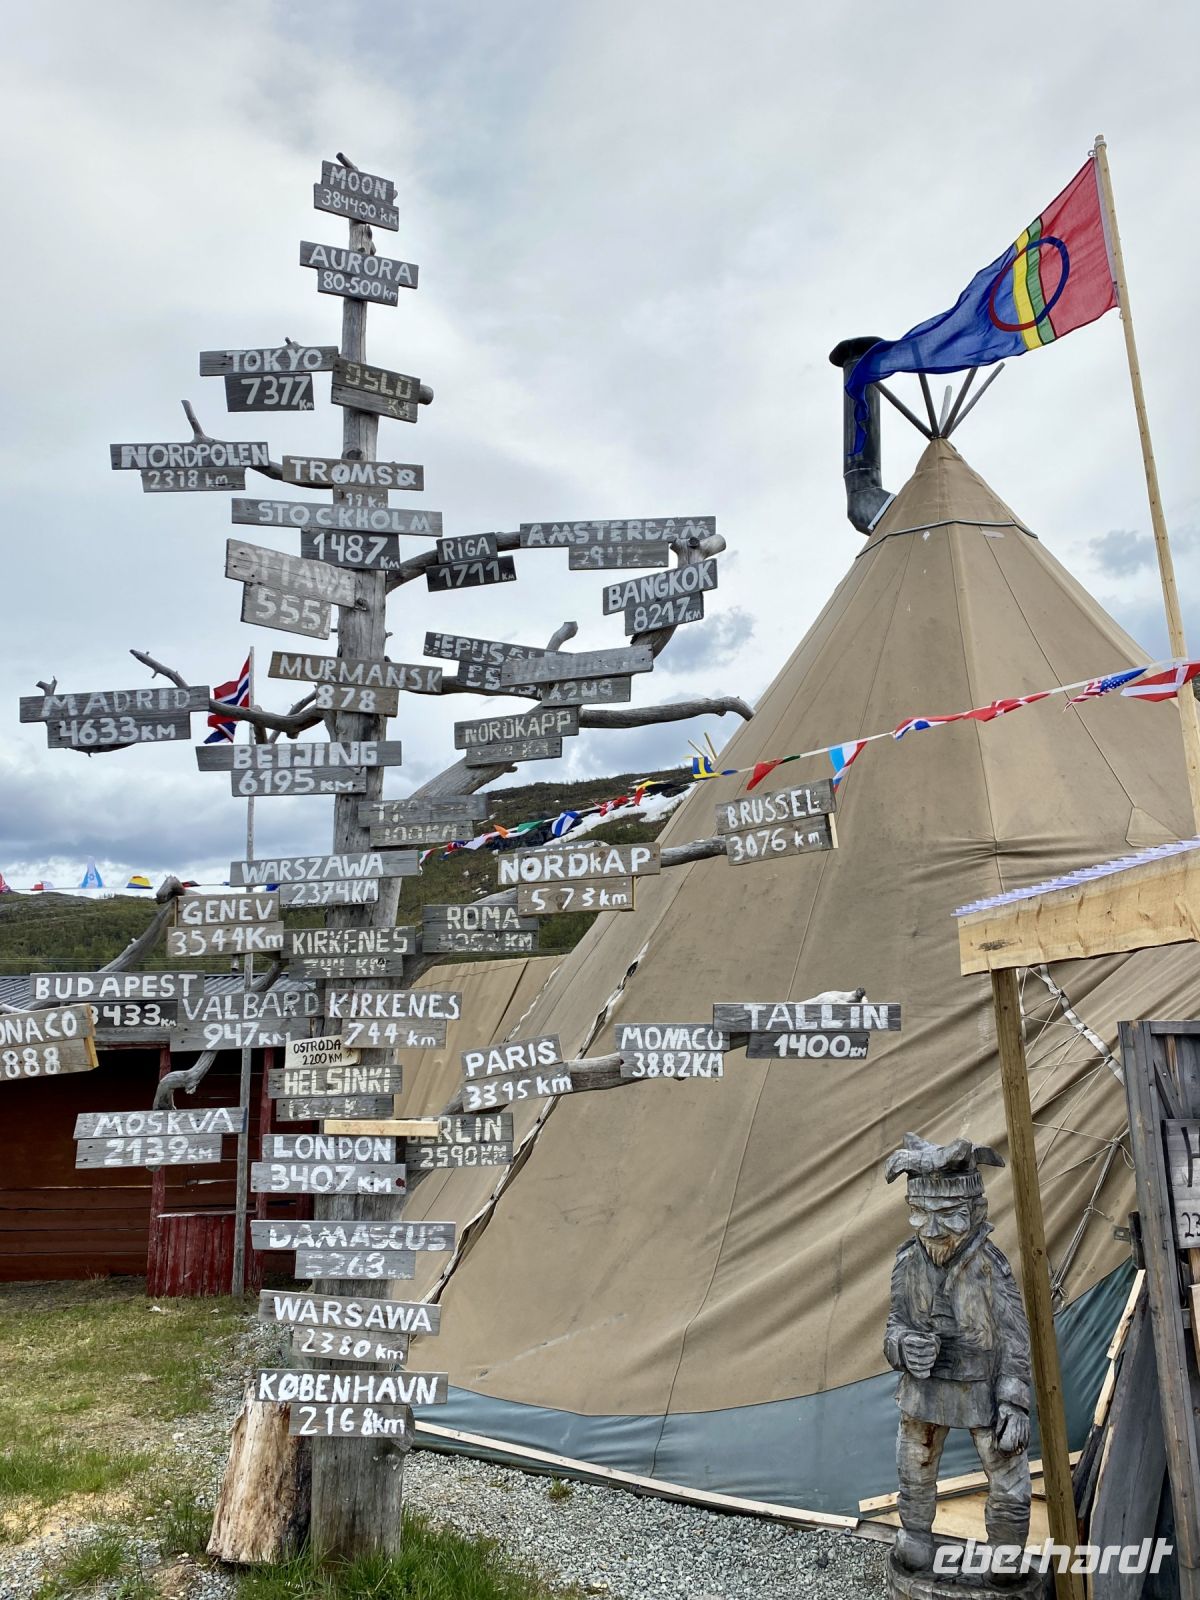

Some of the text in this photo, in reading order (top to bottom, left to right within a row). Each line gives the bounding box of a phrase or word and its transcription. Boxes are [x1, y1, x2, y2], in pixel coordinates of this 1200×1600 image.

[330, 166, 387, 200] MOON
[321, 188, 376, 218] 384400
[309, 245, 413, 284] AURORA
[323, 271, 382, 297] 80-500
[226, 349, 323, 372] TOKYO
[345, 364, 412, 399] OSLO
[120, 443, 269, 468] NORDPOLEN
[149, 469, 198, 488] 2318
[257, 501, 432, 533] STOCKHOLM
[526, 520, 711, 546] AMSTERDAM
[608, 560, 714, 611] BANGKOK
[279, 654, 442, 692] MURMANSK
[41, 688, 190, 717] MADRID
[316, 685, 376, 712] 878
[465, 711, 571, 743] NORDKAPP
[233, 741, 377, 769] BEIJING
[238, 769, 316, 795] 6195
[730, 828, 787, 861] 3076
[241, 854, 384, 884] WARSZAWA
[182, 900, 273, 924] GENEV
[447, 906, 521, 930] ROMA
[293, 927, 408, 955] KIRKENES
[35, 974, 198, 1000] BUDAPEST
[329, 992, 460, 1020] KIRKENES
[344, 1022, 399, 1047] 744
[621, 1027, 723, 1050] MONACO
[302, 1052, 327, 1066] 2200
[465, 1040, 558, 1077] PARIS
[284, 1066, 391, 1095] HELSINKI
[466, 1079, 531, 1109] 3395
[93, 1108, 235, 1137] MOSKVA
[273, 1136, 391, 1162] LONDON
[269, 1223, 447, 1251] DAMASCUS
[274, 1296, 432, 1332] WARSAWA
[301, 1328, 371, 1359] 2380
[258, 1372, 439, 1404] KØBENHAVN
